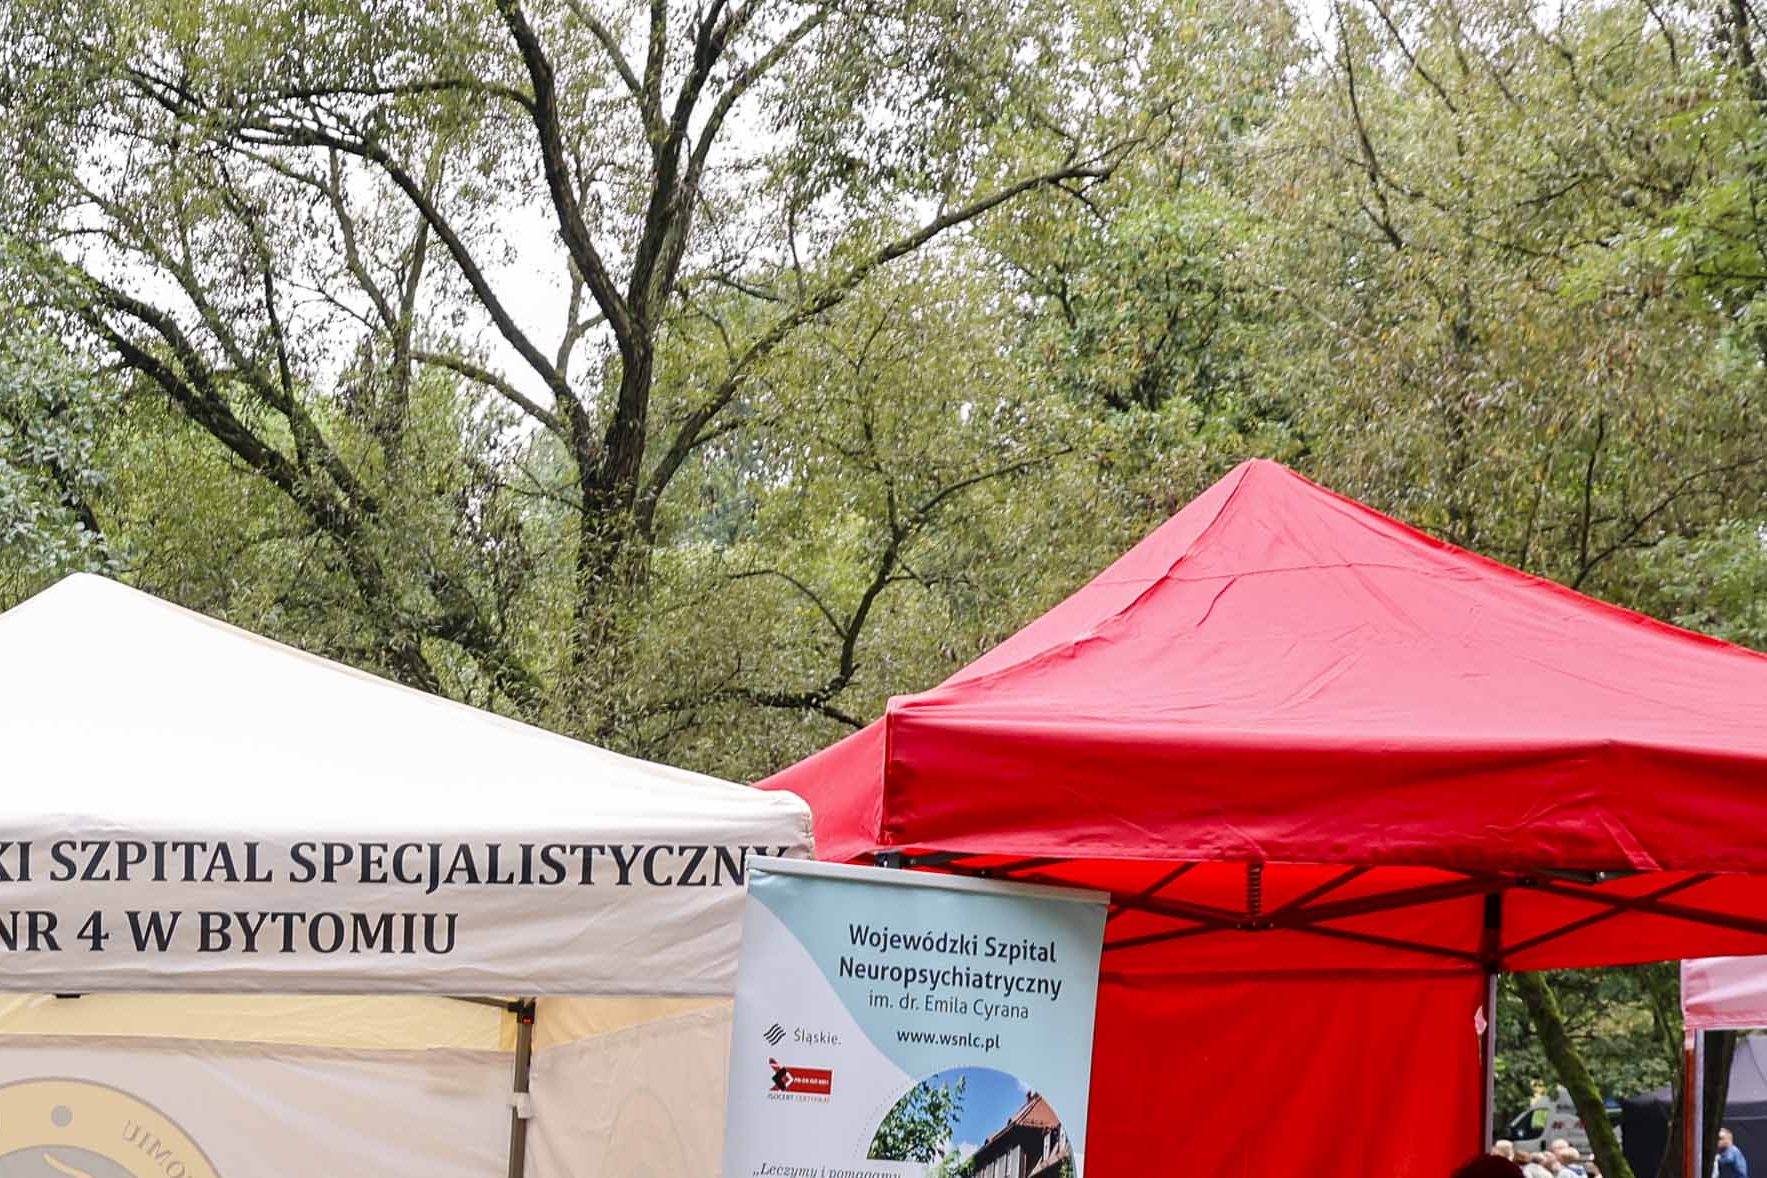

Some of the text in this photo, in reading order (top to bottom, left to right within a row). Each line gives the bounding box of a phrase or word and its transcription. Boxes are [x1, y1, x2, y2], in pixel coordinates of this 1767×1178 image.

[51, 840, 273, 883] SZPITAL
[76, 911, 110, 951] 4
[128, 911, 182, 952] W
[197, 911, 458, 954] BYTOMIU
[849, 924, 1057, 965] Wojewódzki Szpital
[839, 956, 1062, 1001] Neuropsychiatryczny
[869, 990, 1029, 1021] im. dr. Emila Cyrana
[897, 1030, 1001, 1051] www.wsnlc.pl
[821, 1165, 826, 1178] i
